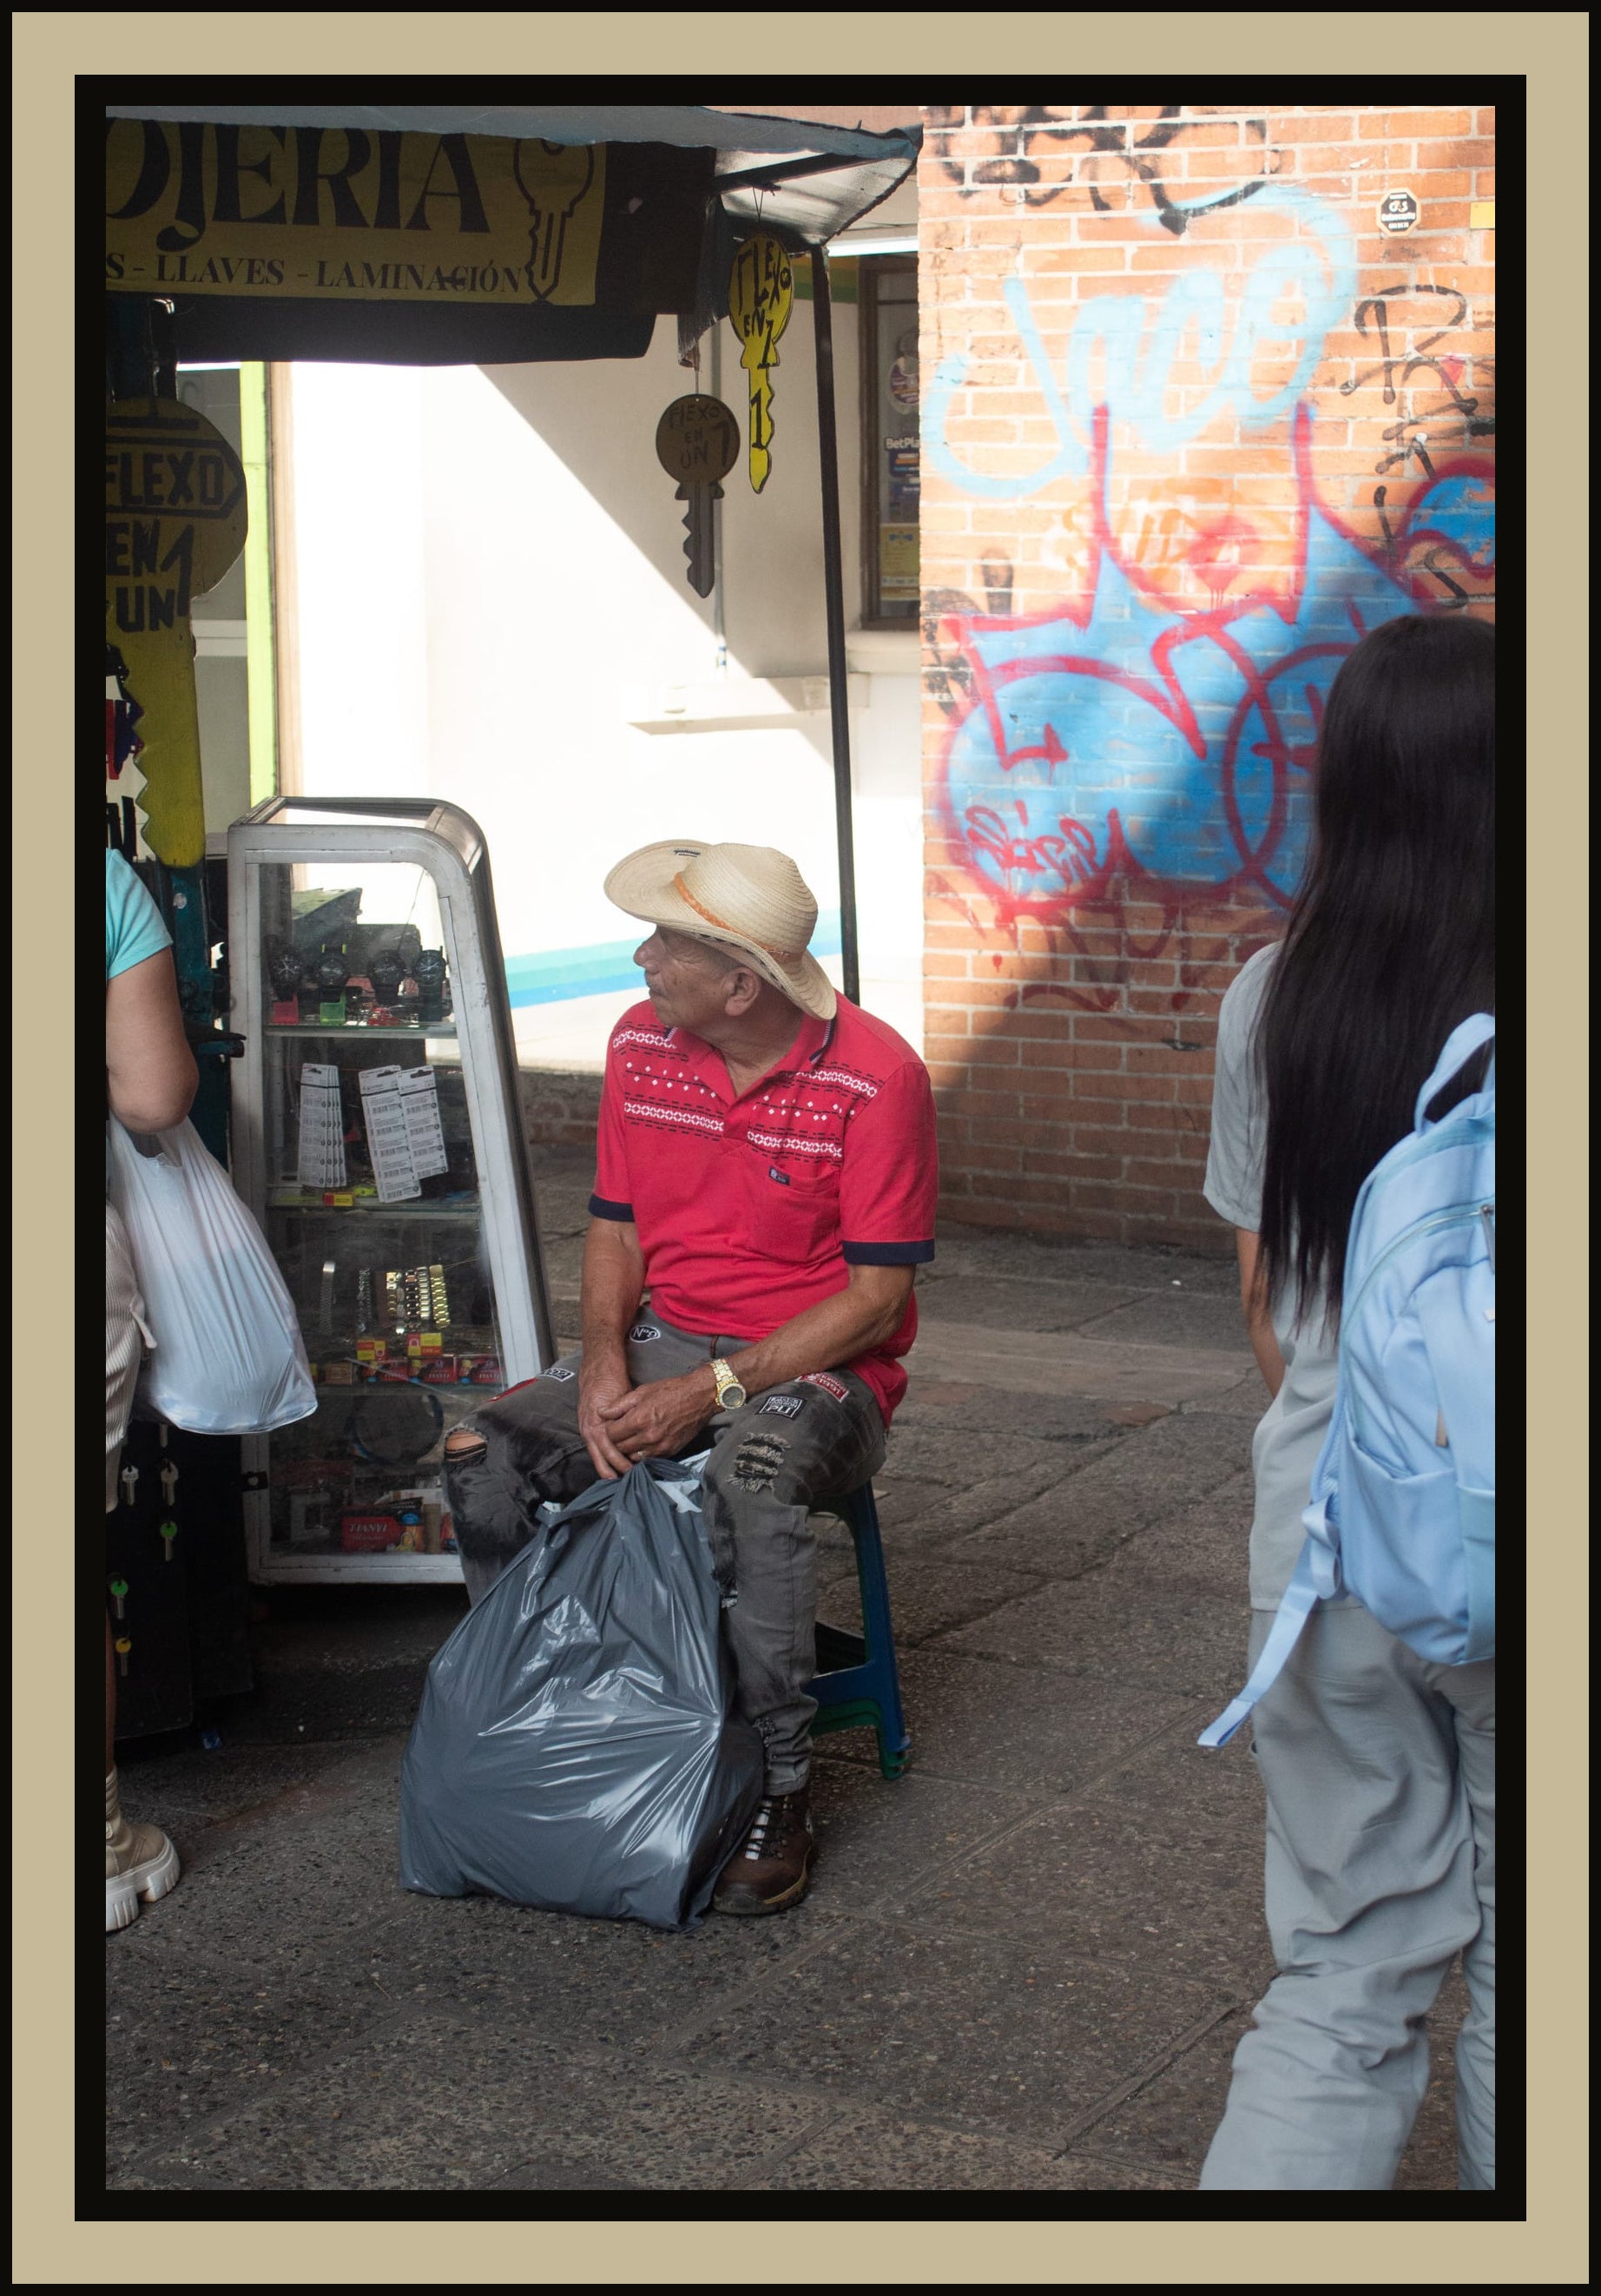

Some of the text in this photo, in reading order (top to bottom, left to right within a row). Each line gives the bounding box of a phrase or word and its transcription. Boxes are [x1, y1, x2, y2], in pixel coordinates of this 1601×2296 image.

[157, 254, 285, 286] LLAVES
[316, 259, 522, 294] LAMINACIÓN
[744, 307, 766, 339] EN
[750, 388, 766, 450] 1
[107, 518, 161, 577] EN
[115, 585, 175, 633] UN
[349, 1523, 388, 1533] TIANYI
